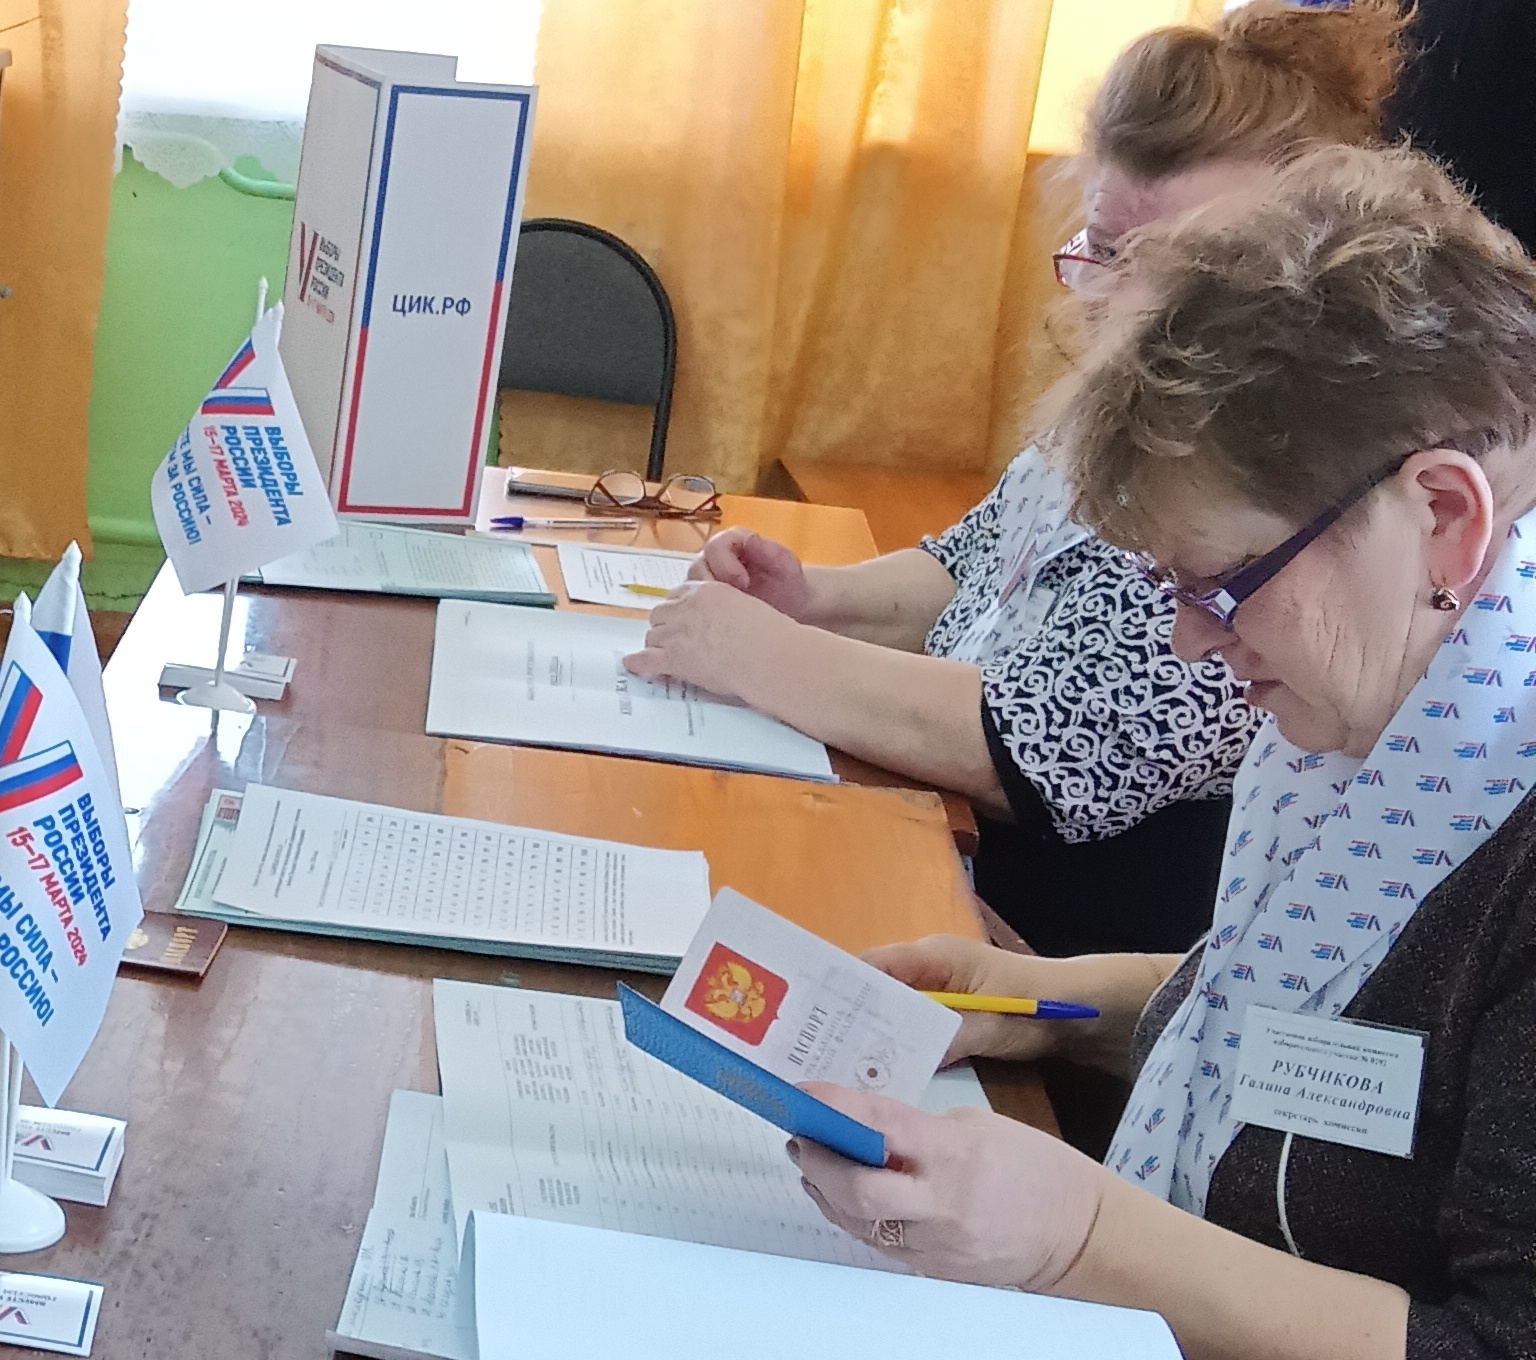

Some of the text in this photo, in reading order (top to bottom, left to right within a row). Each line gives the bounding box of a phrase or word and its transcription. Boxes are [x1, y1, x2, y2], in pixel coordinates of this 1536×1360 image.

[392, 293, 472, 318] ЦИК.РФ
[167, 463, 179, 482] ЗА
[181, 448, 197, 476] МЫ
[220, 425, 257, 489] РОССИИ
[242, 425, 292, 527] ПРЕЗИДЕНТА
[264, 426, 304, 496] ВЫБОРЫ
[188, 475, 211, 515] СИЛА
[213, 458, 239, 498] МАРТА
[228, 499, 250, 528] 2024
[33, 814, 86, 906] РОССИИ
[77, 792, 115, 890] ВЫБОРЫ
[58, 803, 112, 943] ПРЕЗИДЕНТА
[16, 913, 54, 974] СИЛА
[39, 871, 75, 930] МАРТА
[67, 926, 89, 968] 2024
[788, 1005, 827, 1066] ПАСПОРТ
[1239, 1073, 1411, 1120] Галина Александровна
[1272, 1059, 1384, 1095] РУБЧИКОВА
